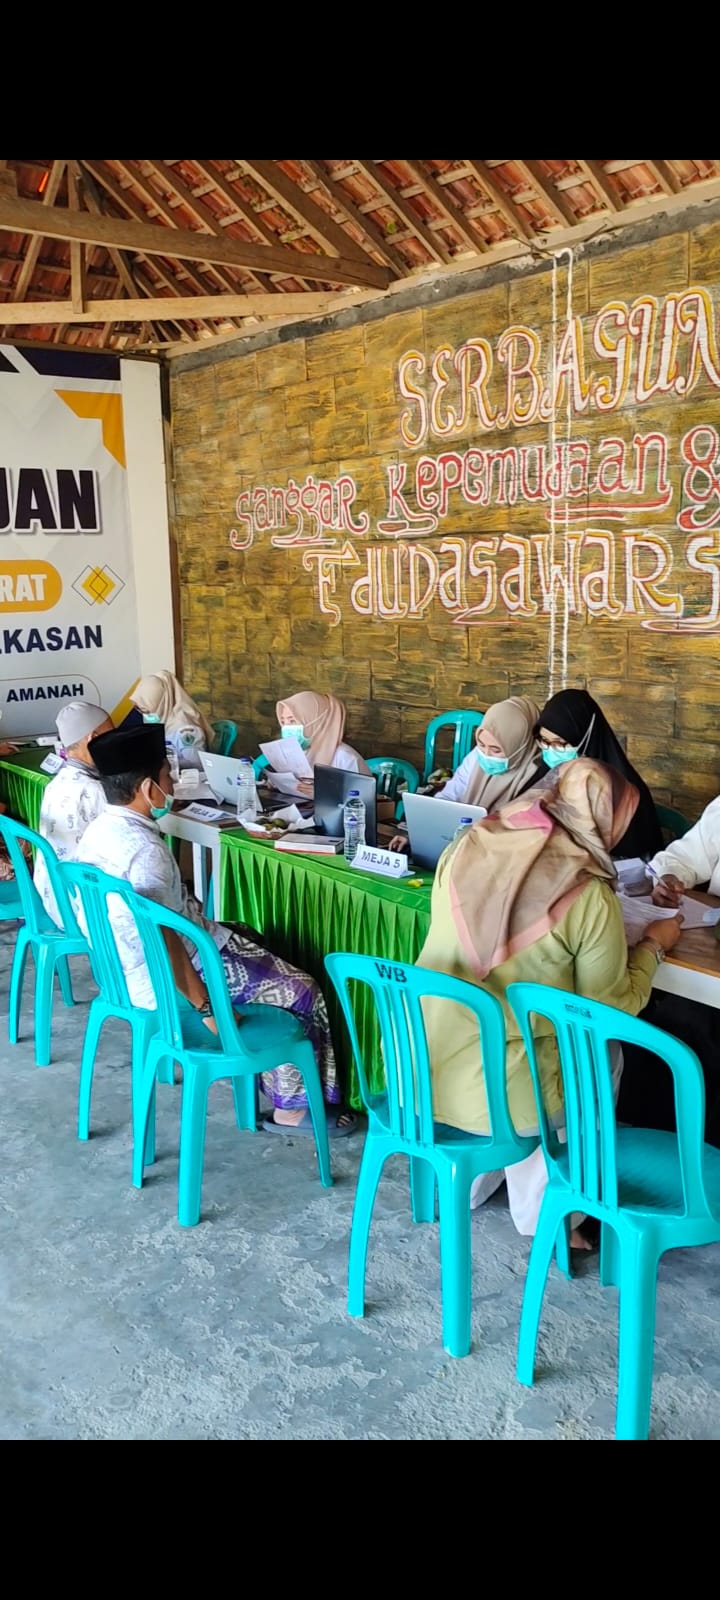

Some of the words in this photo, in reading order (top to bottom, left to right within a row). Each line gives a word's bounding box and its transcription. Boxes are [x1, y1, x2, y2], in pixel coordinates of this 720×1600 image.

[0, 625, 103, 655] KASAN
[6, 683, 85, 703] AMANAH
[361, 850, 391, 867] MEJA
[393, 858, 401, 869] 5
[374, 962, 408, 983] WB
